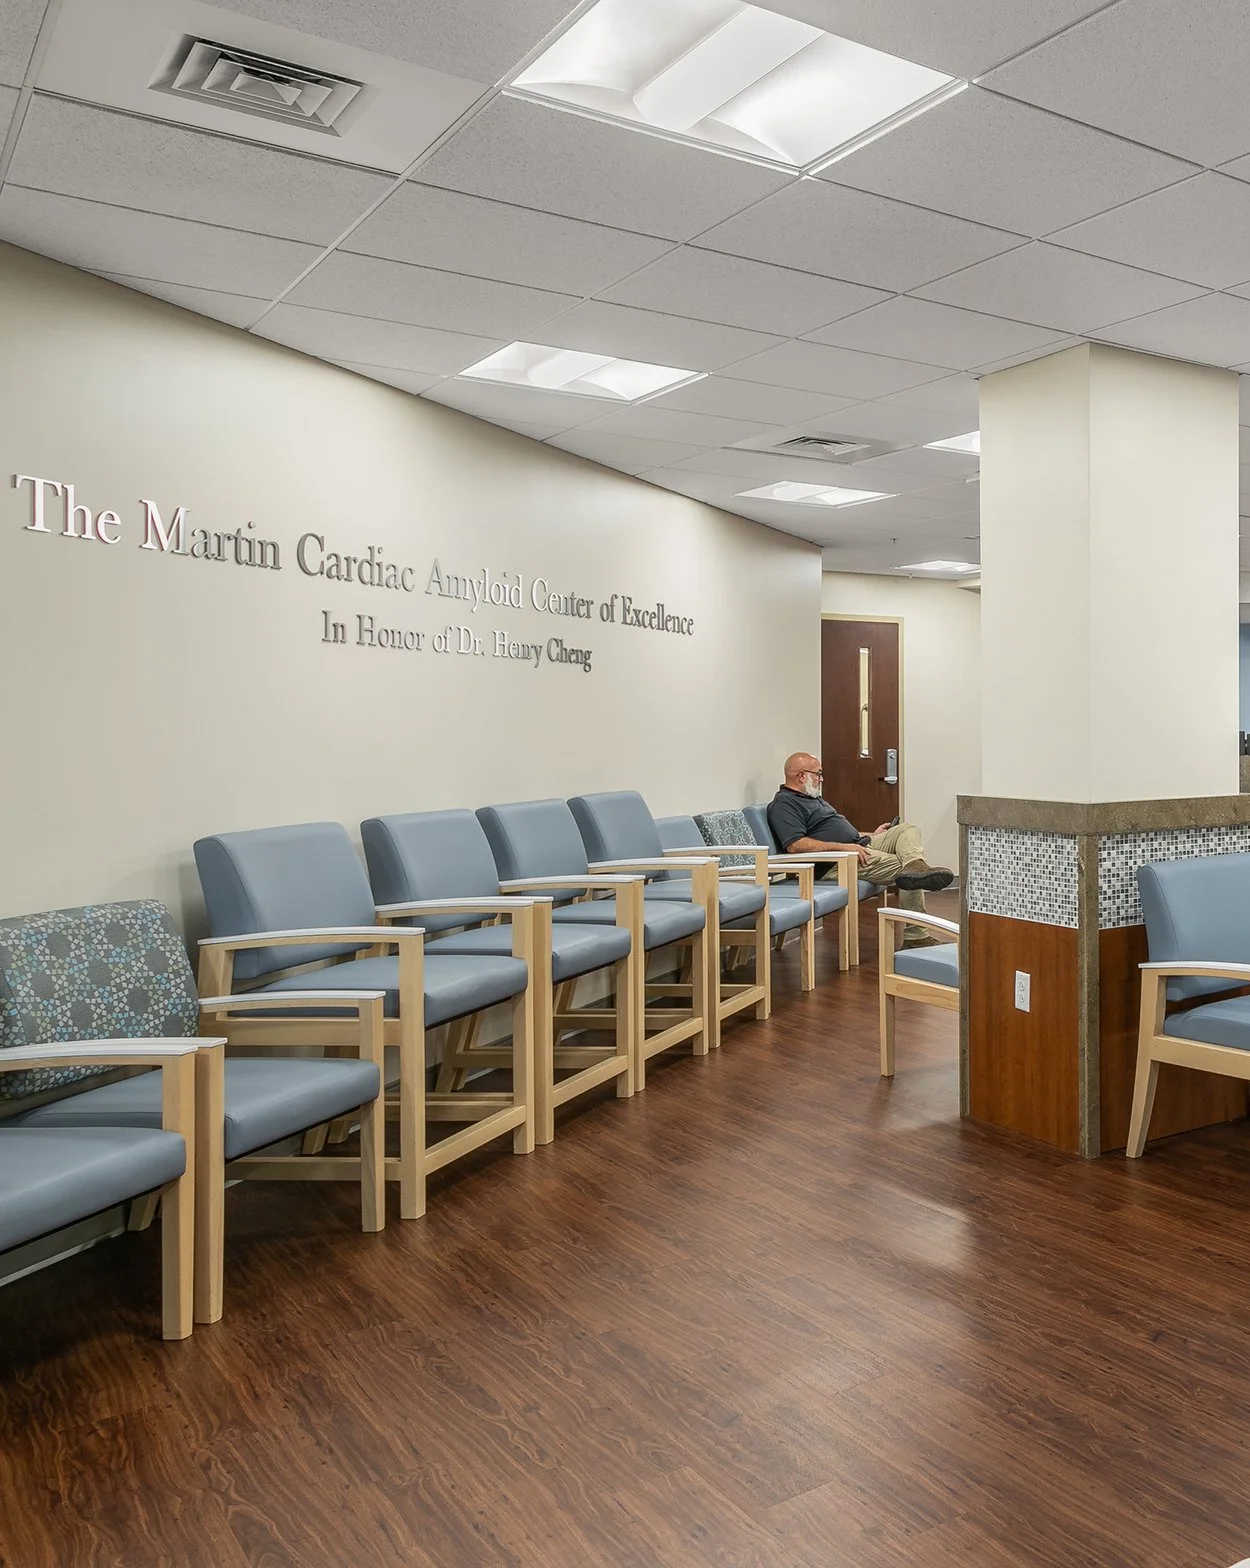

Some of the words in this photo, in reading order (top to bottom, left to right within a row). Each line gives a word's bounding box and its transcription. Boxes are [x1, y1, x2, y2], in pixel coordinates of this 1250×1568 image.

[11, 474, 122, 544] The
[138, 498, 282, 570] Martin
[296, 532, 416, 593] Cardiac
[424, 558, 524, 613] Amyloid
[530, 577, 594, 620] Center
[600, 594, 619, 623] of
[621, 595, 695, 636] Excellence
[321, 609, 347, 644] In
[356, 613, 425, 651] Honor
[432, 624, 455, 654] of
[456, 626, 486, 656] Dr.
[492, 630, 543, 668] Henry
[547, 637, 592, 673] Cheng
